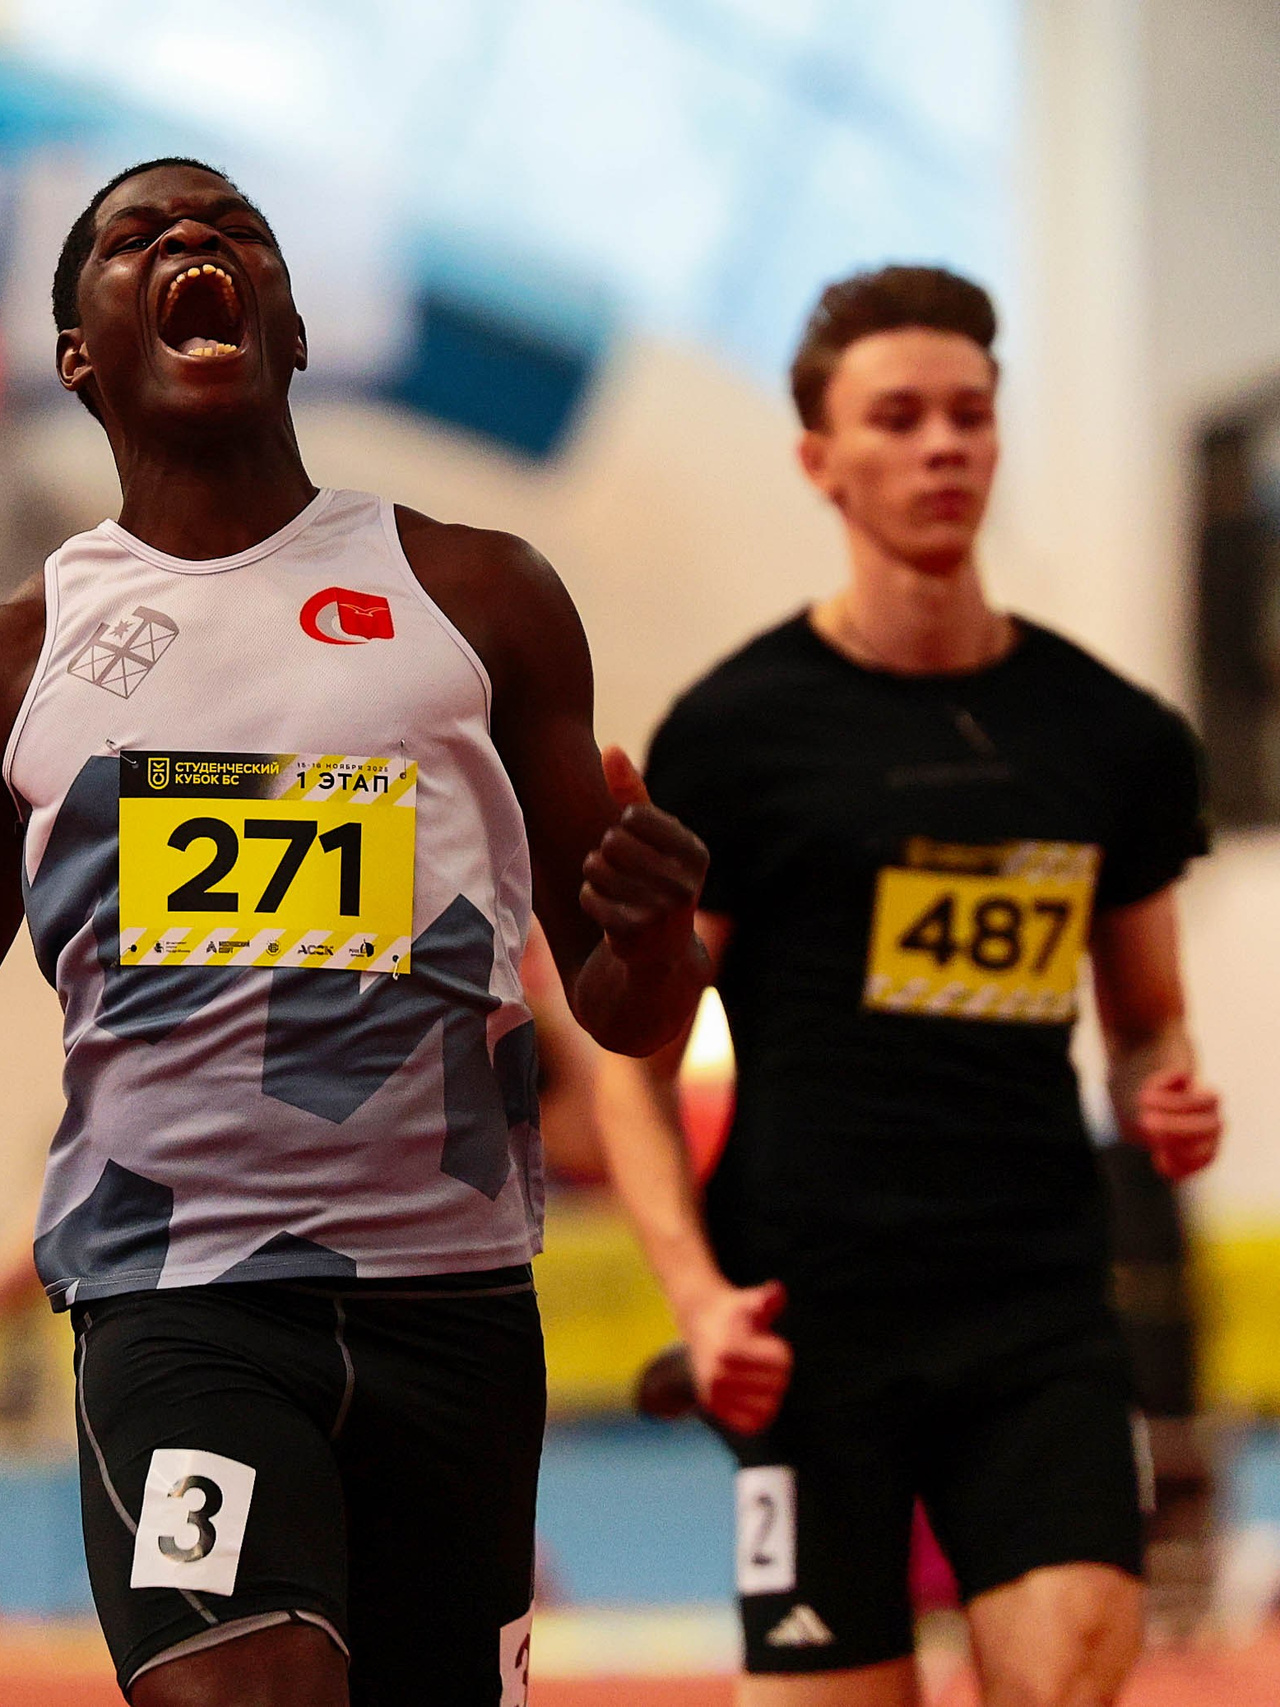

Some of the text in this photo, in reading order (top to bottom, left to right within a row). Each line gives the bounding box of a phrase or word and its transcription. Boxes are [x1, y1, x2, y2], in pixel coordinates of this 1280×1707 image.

[174, 761, 280, 774] СТУДЕНЧЕСКИЙ
[175, 773, 240, 785] КУБОК БС
[297, 771, 389, 793] 1 ЭТАП
[326, 763, 363, 771] НОЯБРЯ
[167, 817, 362, 917] 271
[899, 895, 1070, 975] 487
[158, 1475, 223, 1563] 3
[749, 1494, 776, 1567] 2
